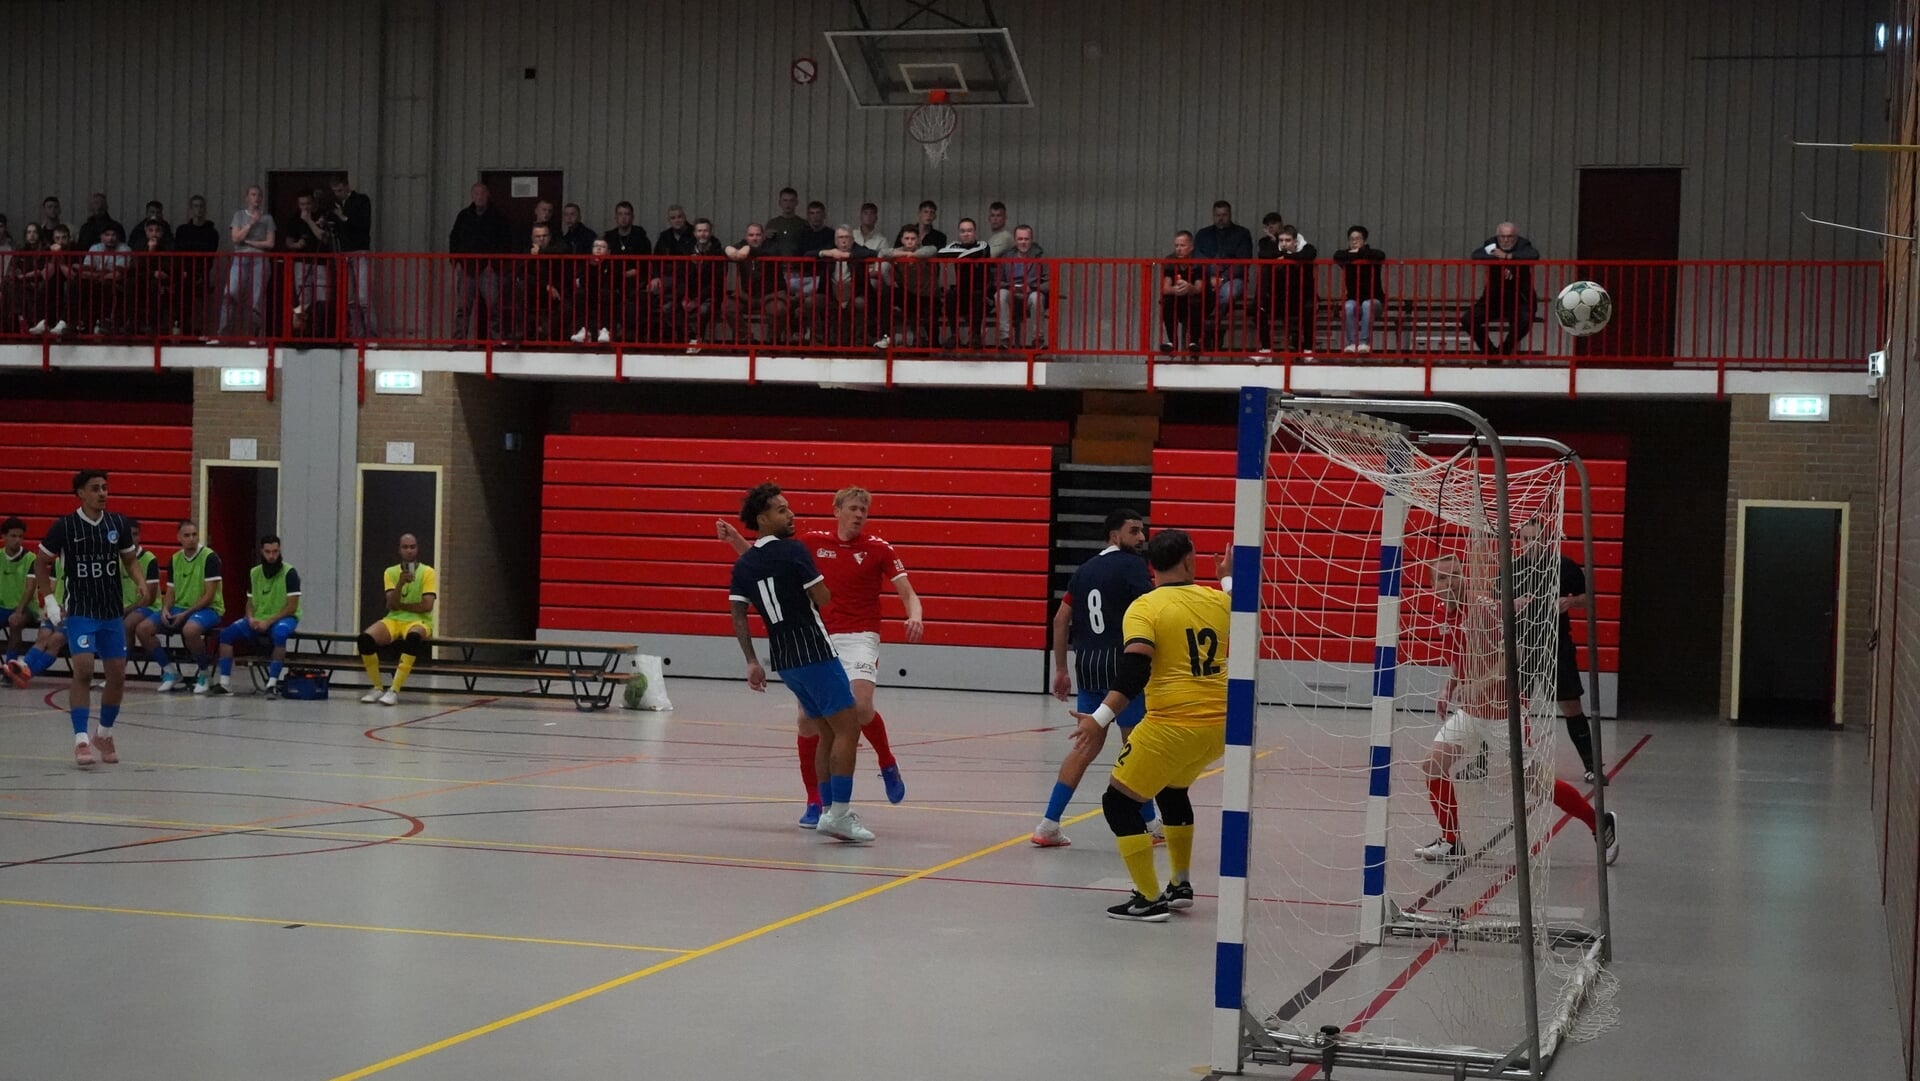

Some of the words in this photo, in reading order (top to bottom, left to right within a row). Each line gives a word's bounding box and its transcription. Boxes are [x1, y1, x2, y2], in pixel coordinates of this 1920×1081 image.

[77, 561, 117, 578] BBG
[757, 576, 784, 624] 11
[1087, 588, 1105, 634] 8
[1186, 628, 1220, 676] 12
